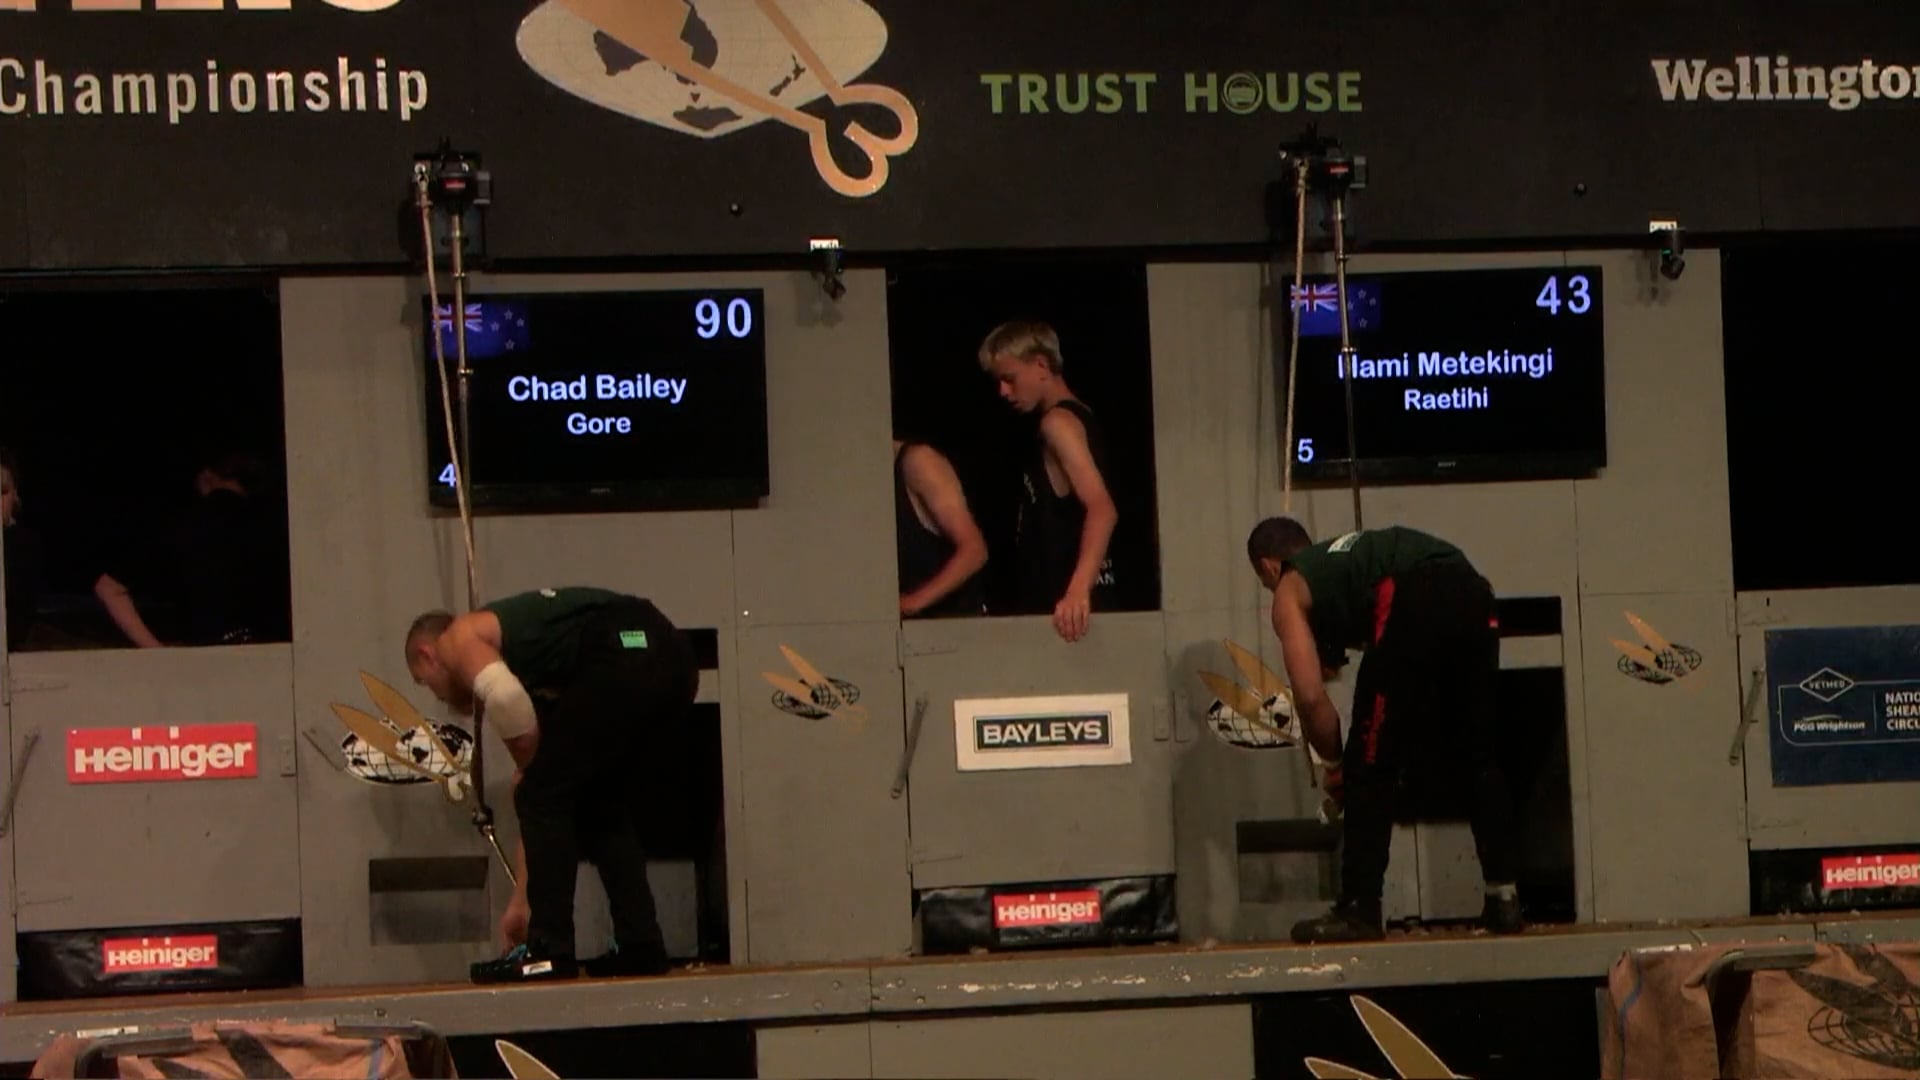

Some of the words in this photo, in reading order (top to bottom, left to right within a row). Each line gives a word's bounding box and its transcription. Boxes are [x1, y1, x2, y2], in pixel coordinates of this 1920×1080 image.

[0, 57, 428, 124] Championship
[980, 73, 1157, 114] TRUST
[1184, 72, 1363, 115] HOUSE
[1535, 275, 1592, 315] 43
[695, 298, 753, 339] 90
[1418, 348, 1553, 379] Metekingi
[508, 374, 587, 401] Chad
[595, 373, 687, 404] Bailey
[1404, 387, 1489, 411] Raetihi
[567, 412, 632, 435] Gore
[1298, 438, 1315, 463] 5
[438, 463, 457, 487] 4
[1886, 705, 1920, 717] SHEA
[983, 720, 1102, 744] BAYLEYS
[74, 726, 253, 777] Heiniger
[1826, 856, 1920, 885] Heiniger
[998, 894, 1099, 924] Heiniger
[108, 937, 215, 969] Heiniger
